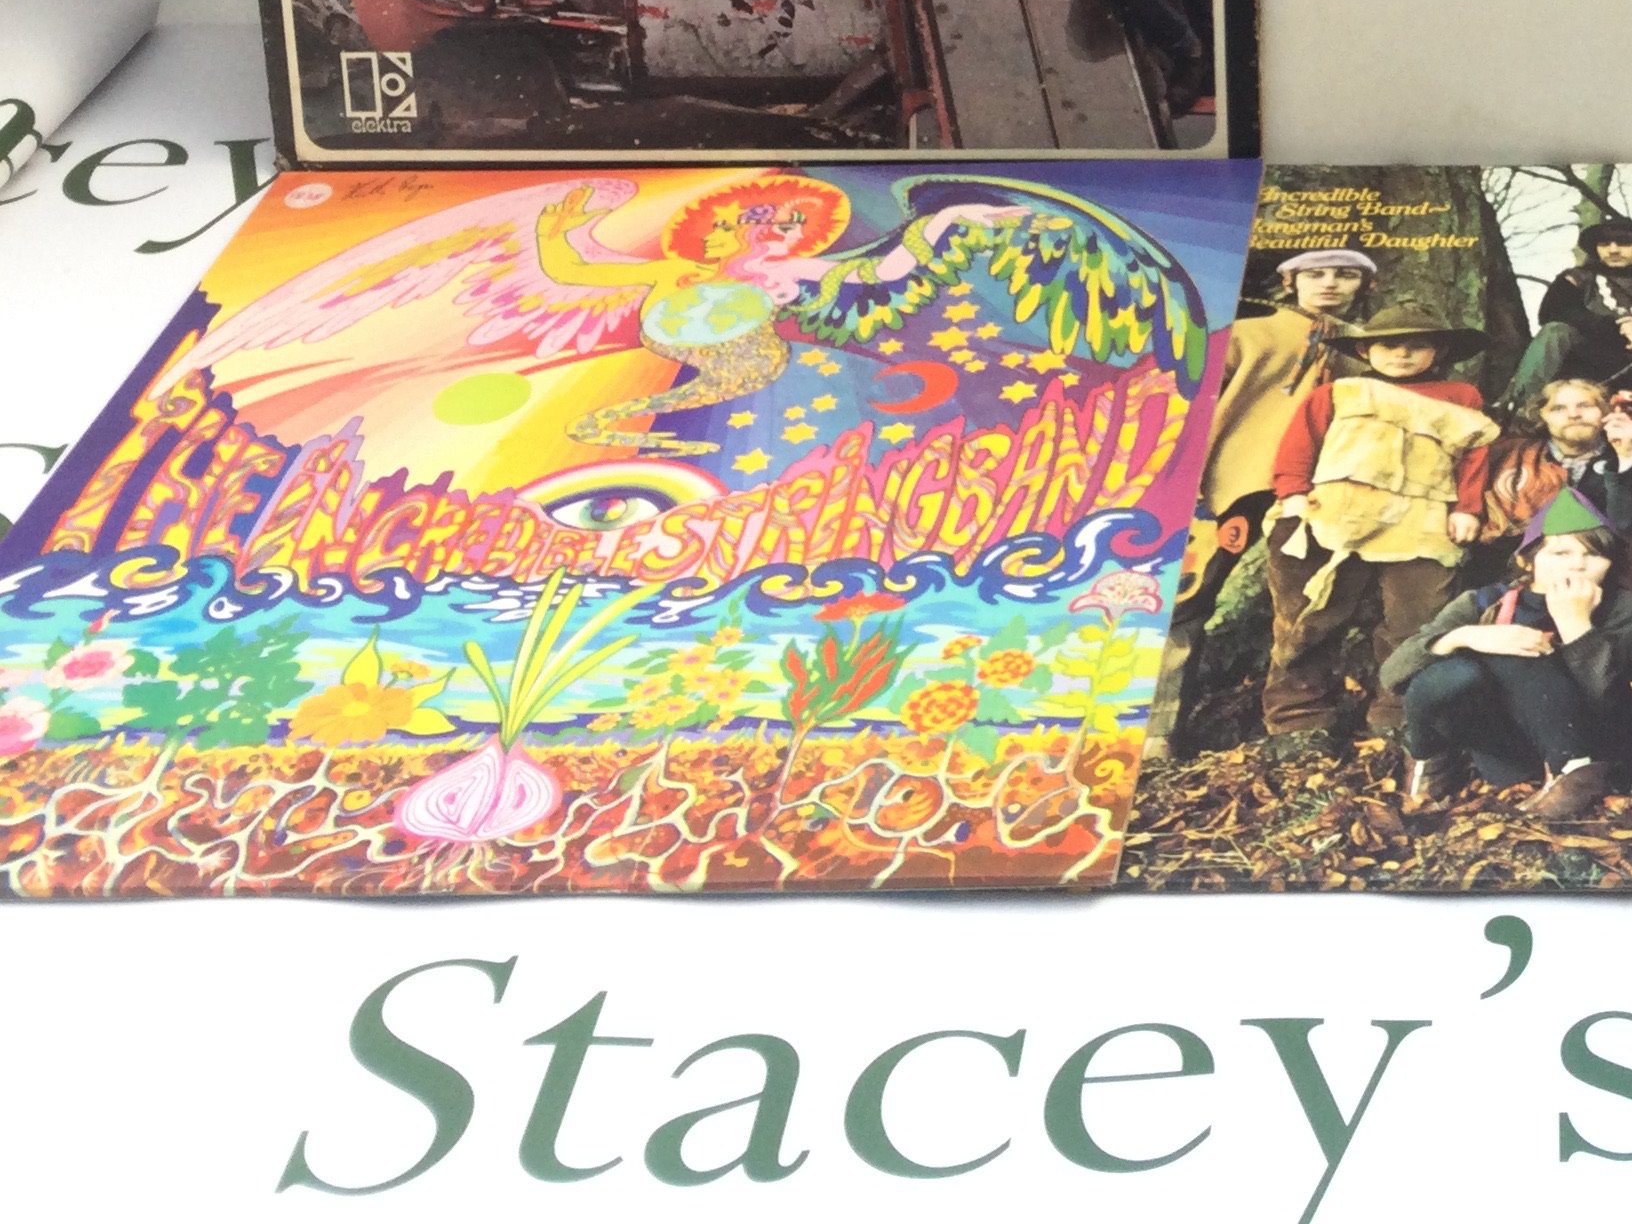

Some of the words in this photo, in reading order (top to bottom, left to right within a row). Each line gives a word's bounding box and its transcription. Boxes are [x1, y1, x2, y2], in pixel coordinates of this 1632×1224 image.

[351, 117, 413, 134] elektra
[1275, 202, 1352, 219] String
[1359, 231, 1479, 251] Daughter
